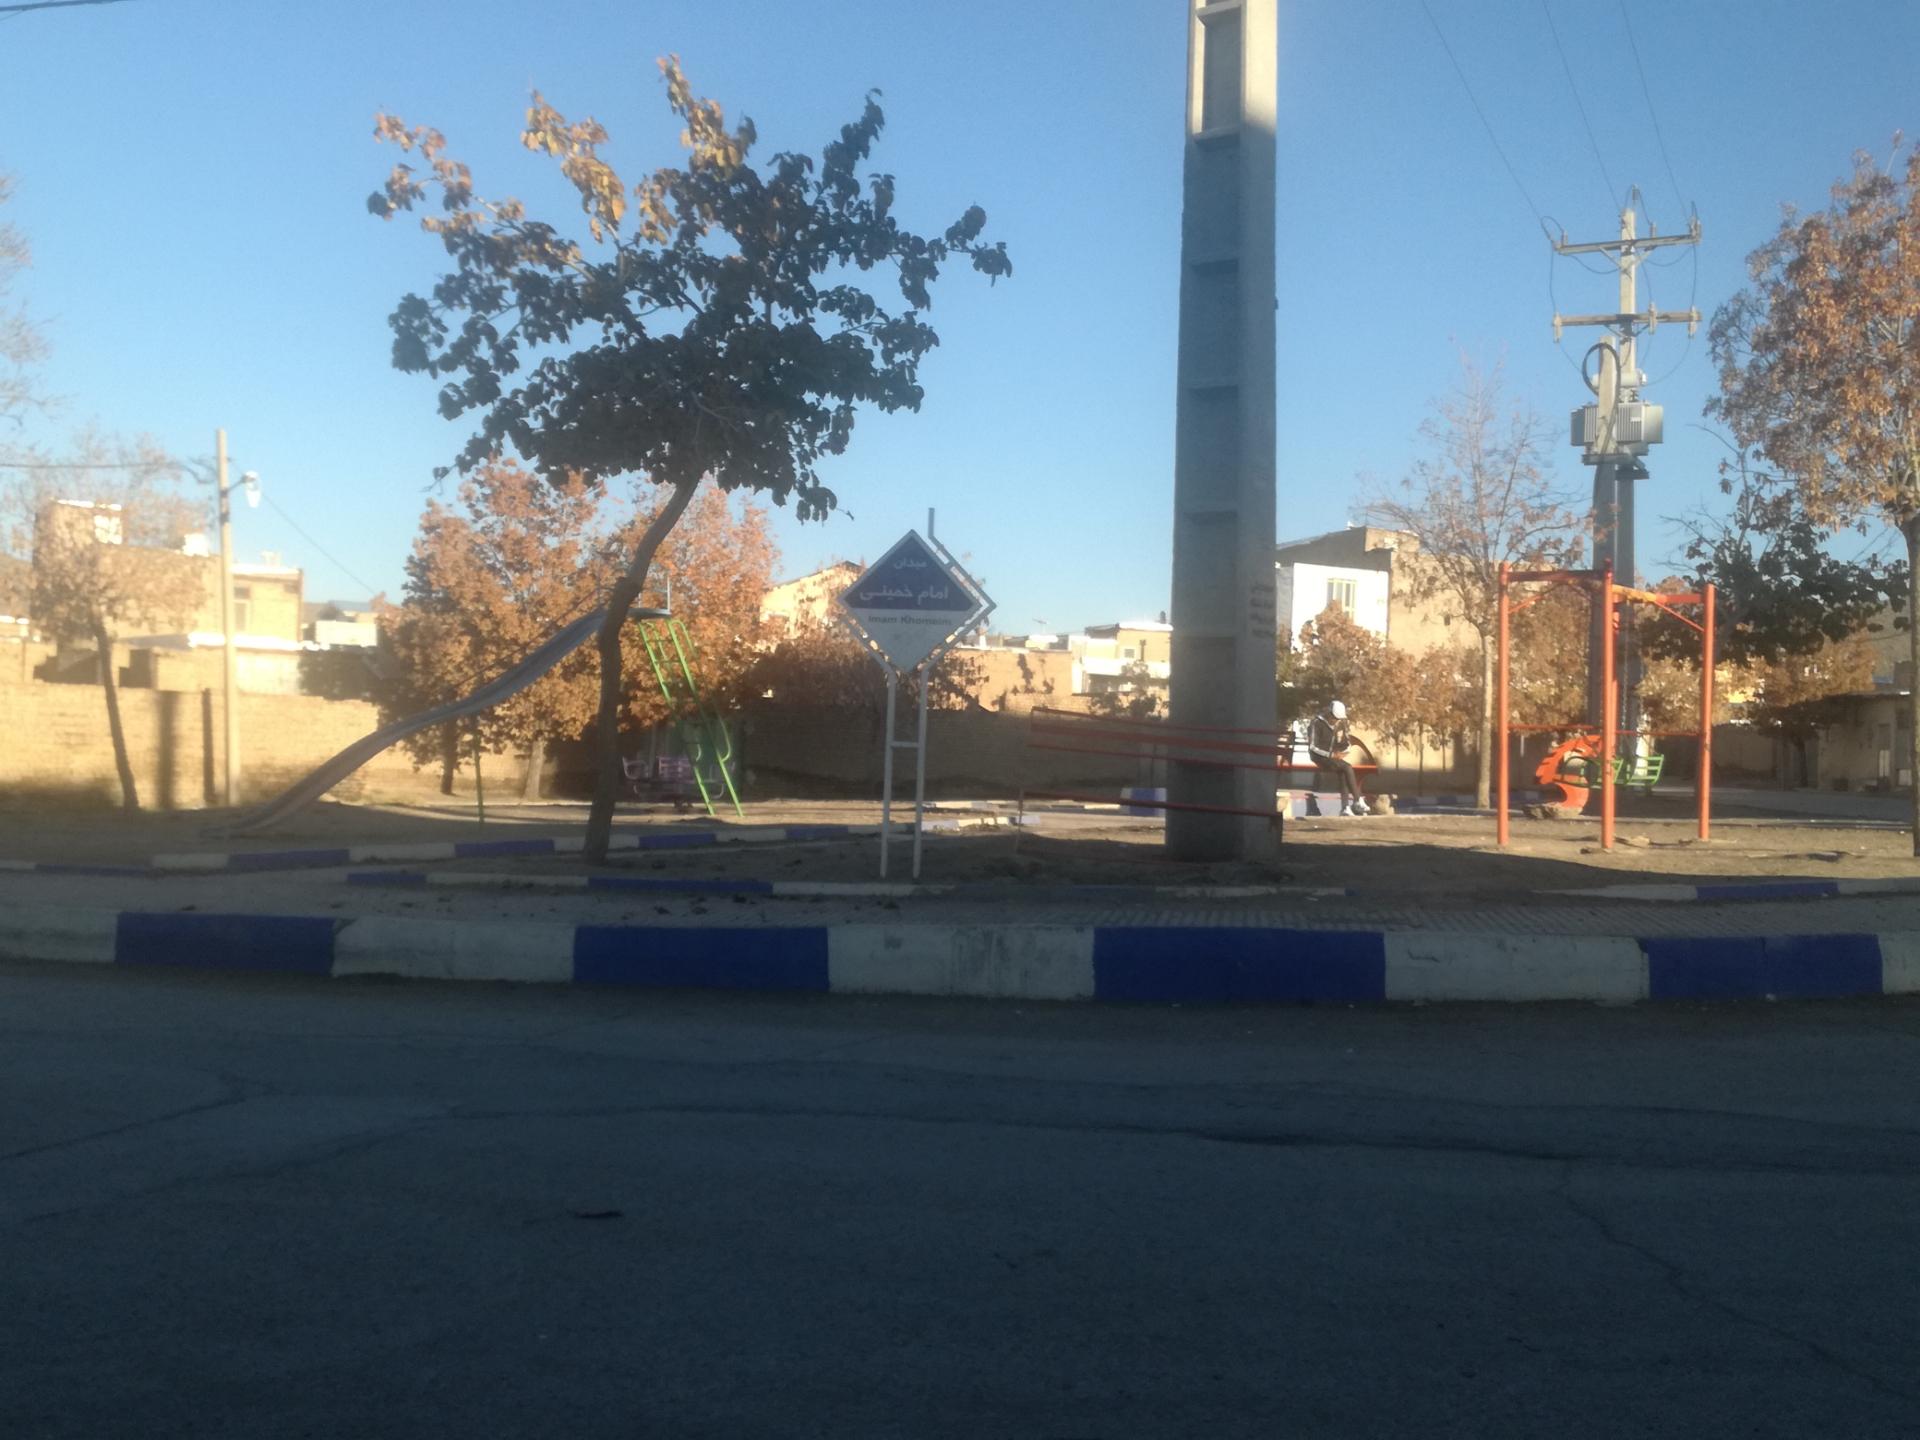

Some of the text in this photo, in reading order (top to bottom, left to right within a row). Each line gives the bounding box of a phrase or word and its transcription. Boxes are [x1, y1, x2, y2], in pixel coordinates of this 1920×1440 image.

[894, 558, 927, 569] میدان
[860, 584, 948, 605] امام خمینی
[868, 615, 897, 624] Imam
